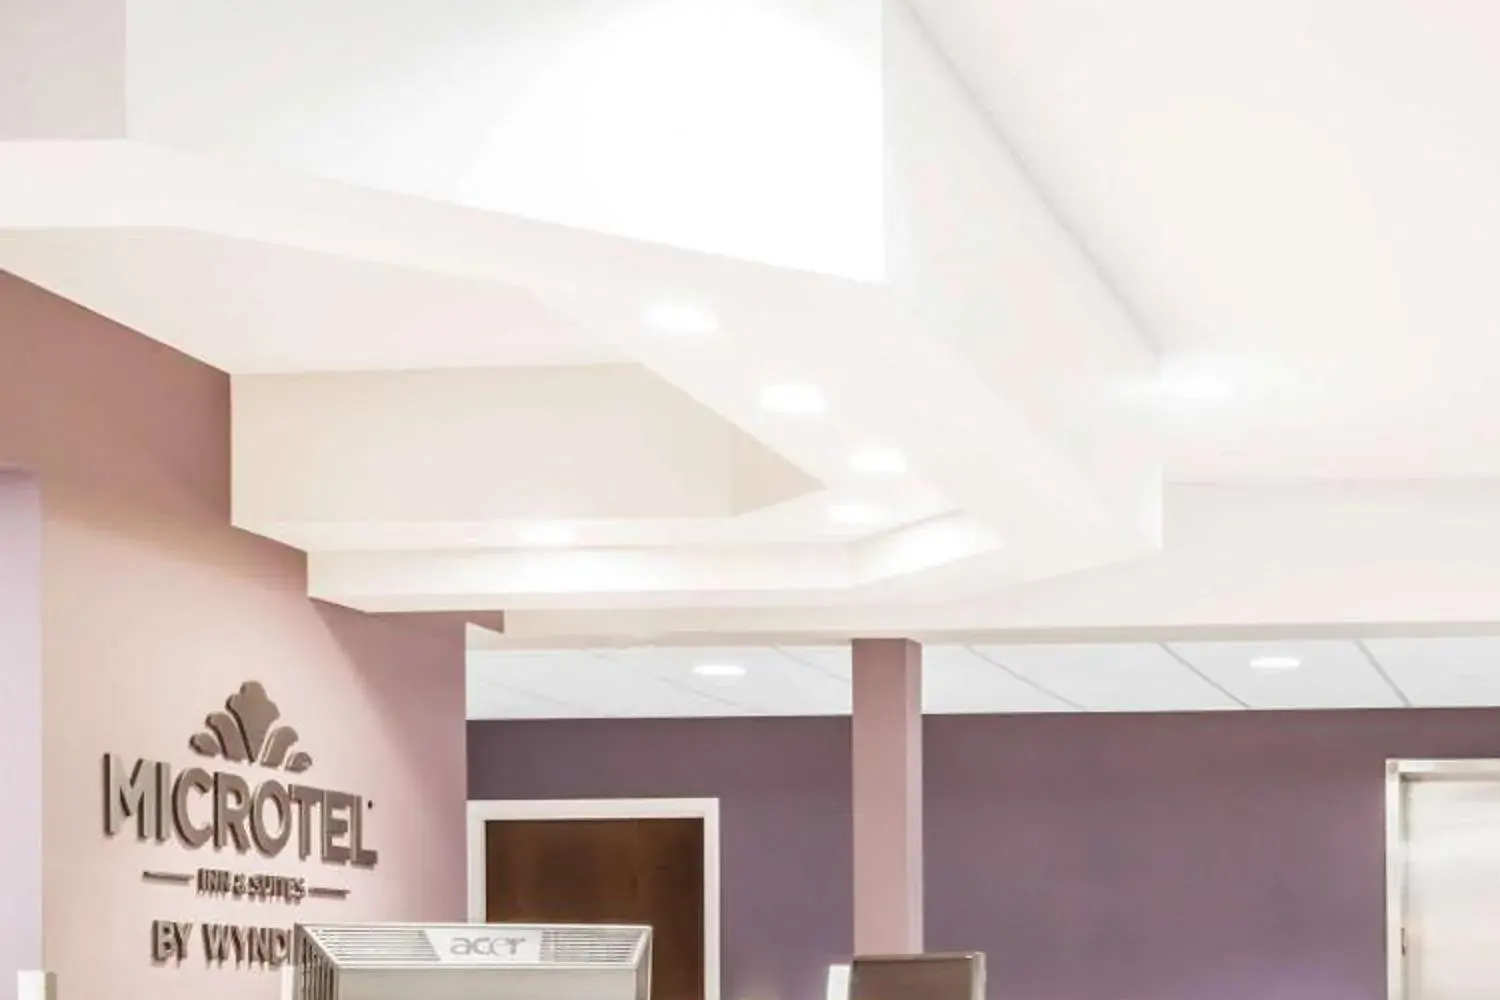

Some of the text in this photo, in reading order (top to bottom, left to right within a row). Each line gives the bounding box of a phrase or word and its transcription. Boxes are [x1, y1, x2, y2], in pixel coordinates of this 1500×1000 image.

[102, 752, 379, 870] MICROTEL
[151, 919, 193, 966] BY
[450, 936, 527, 957] acer
